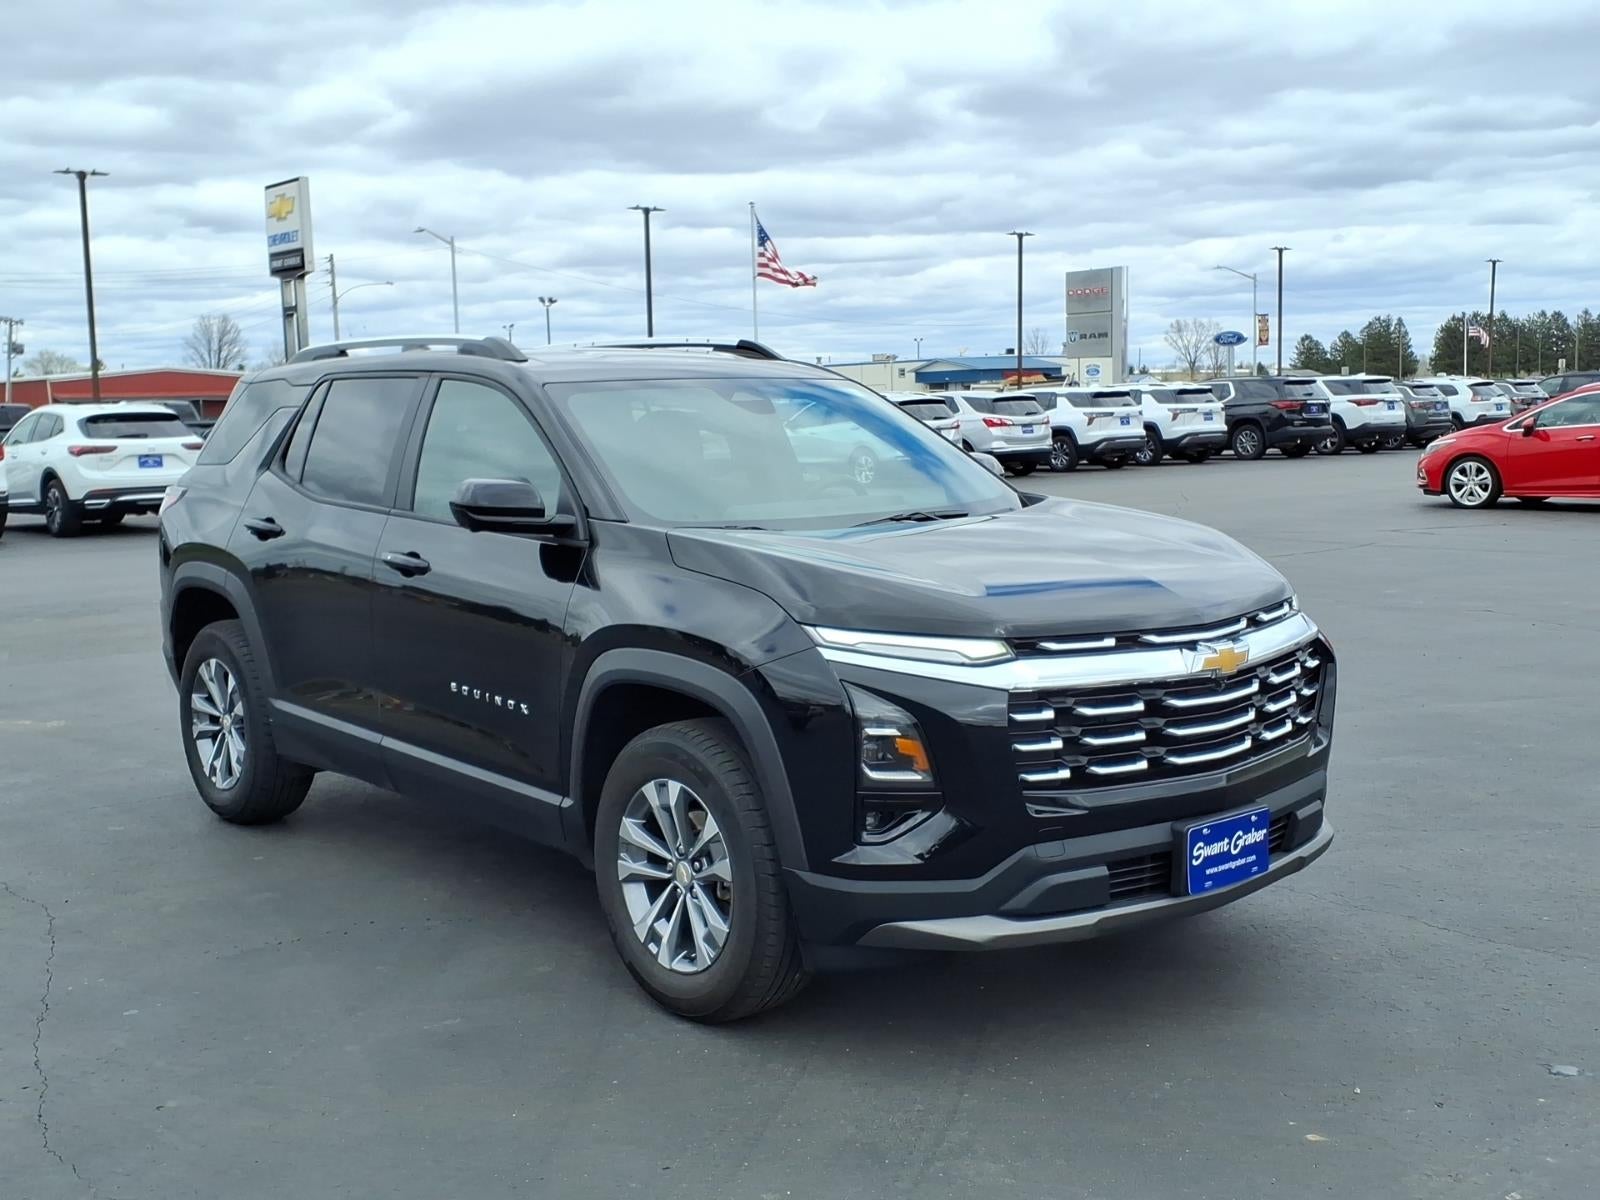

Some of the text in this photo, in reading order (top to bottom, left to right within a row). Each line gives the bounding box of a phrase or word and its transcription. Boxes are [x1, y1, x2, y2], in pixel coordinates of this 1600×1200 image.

[1067, 287, 1109, 297] DODGE
[1079, 332, 1108, 341] RAM
[1218, 333, 1238, 344] Ford
[450, 681, 529, 715] EQUINOX
[1192, 827, 1267, 866] Swant Graber
[1205, 854, 1257, 875] www.swantgraber.com
